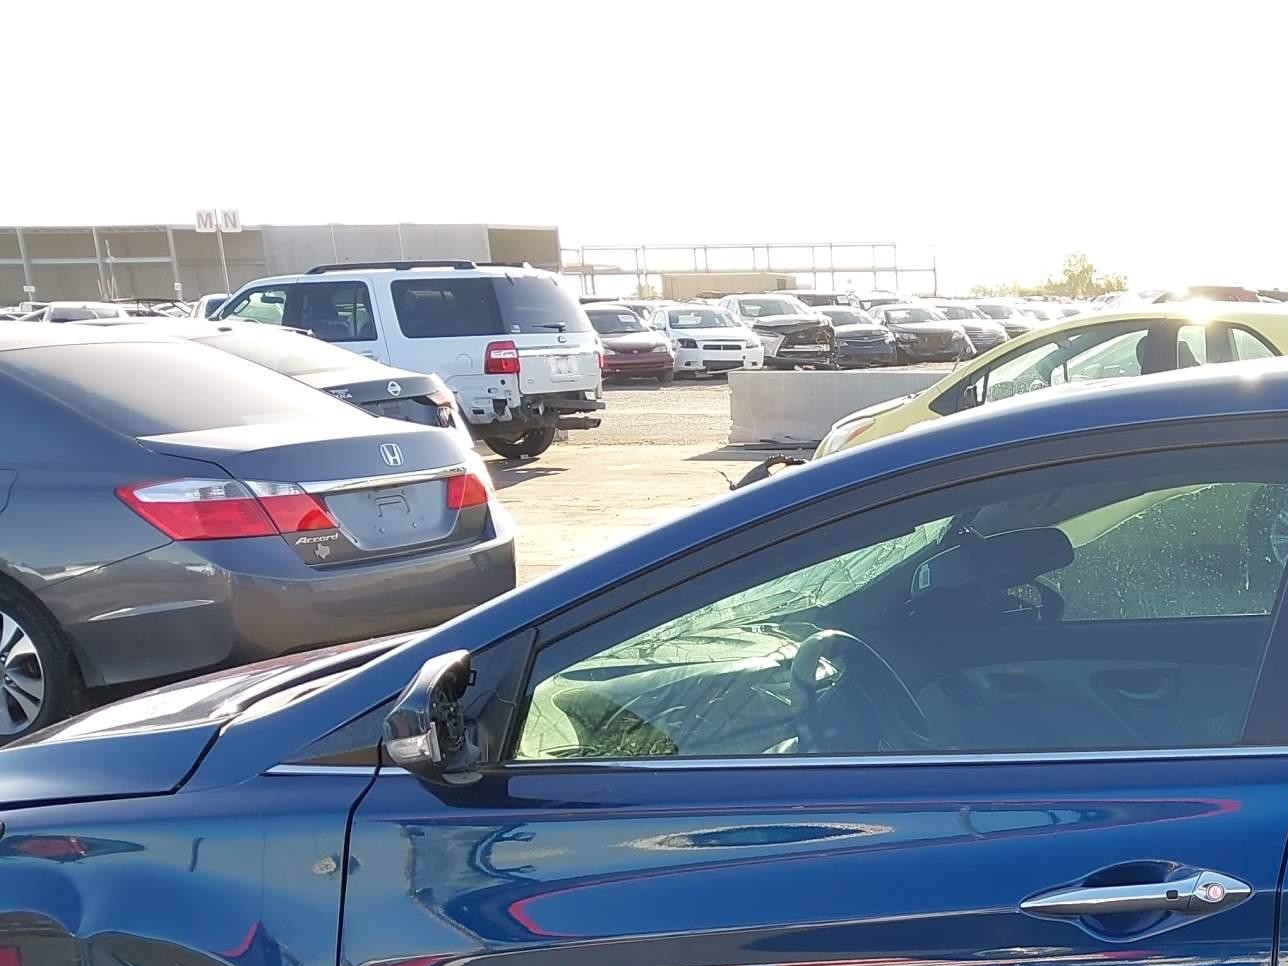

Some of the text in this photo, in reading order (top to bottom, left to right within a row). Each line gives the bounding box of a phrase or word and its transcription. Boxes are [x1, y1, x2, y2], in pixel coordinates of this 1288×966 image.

[196, 211, 238, 229] M N
[294, 532, 339, 546] Accord
